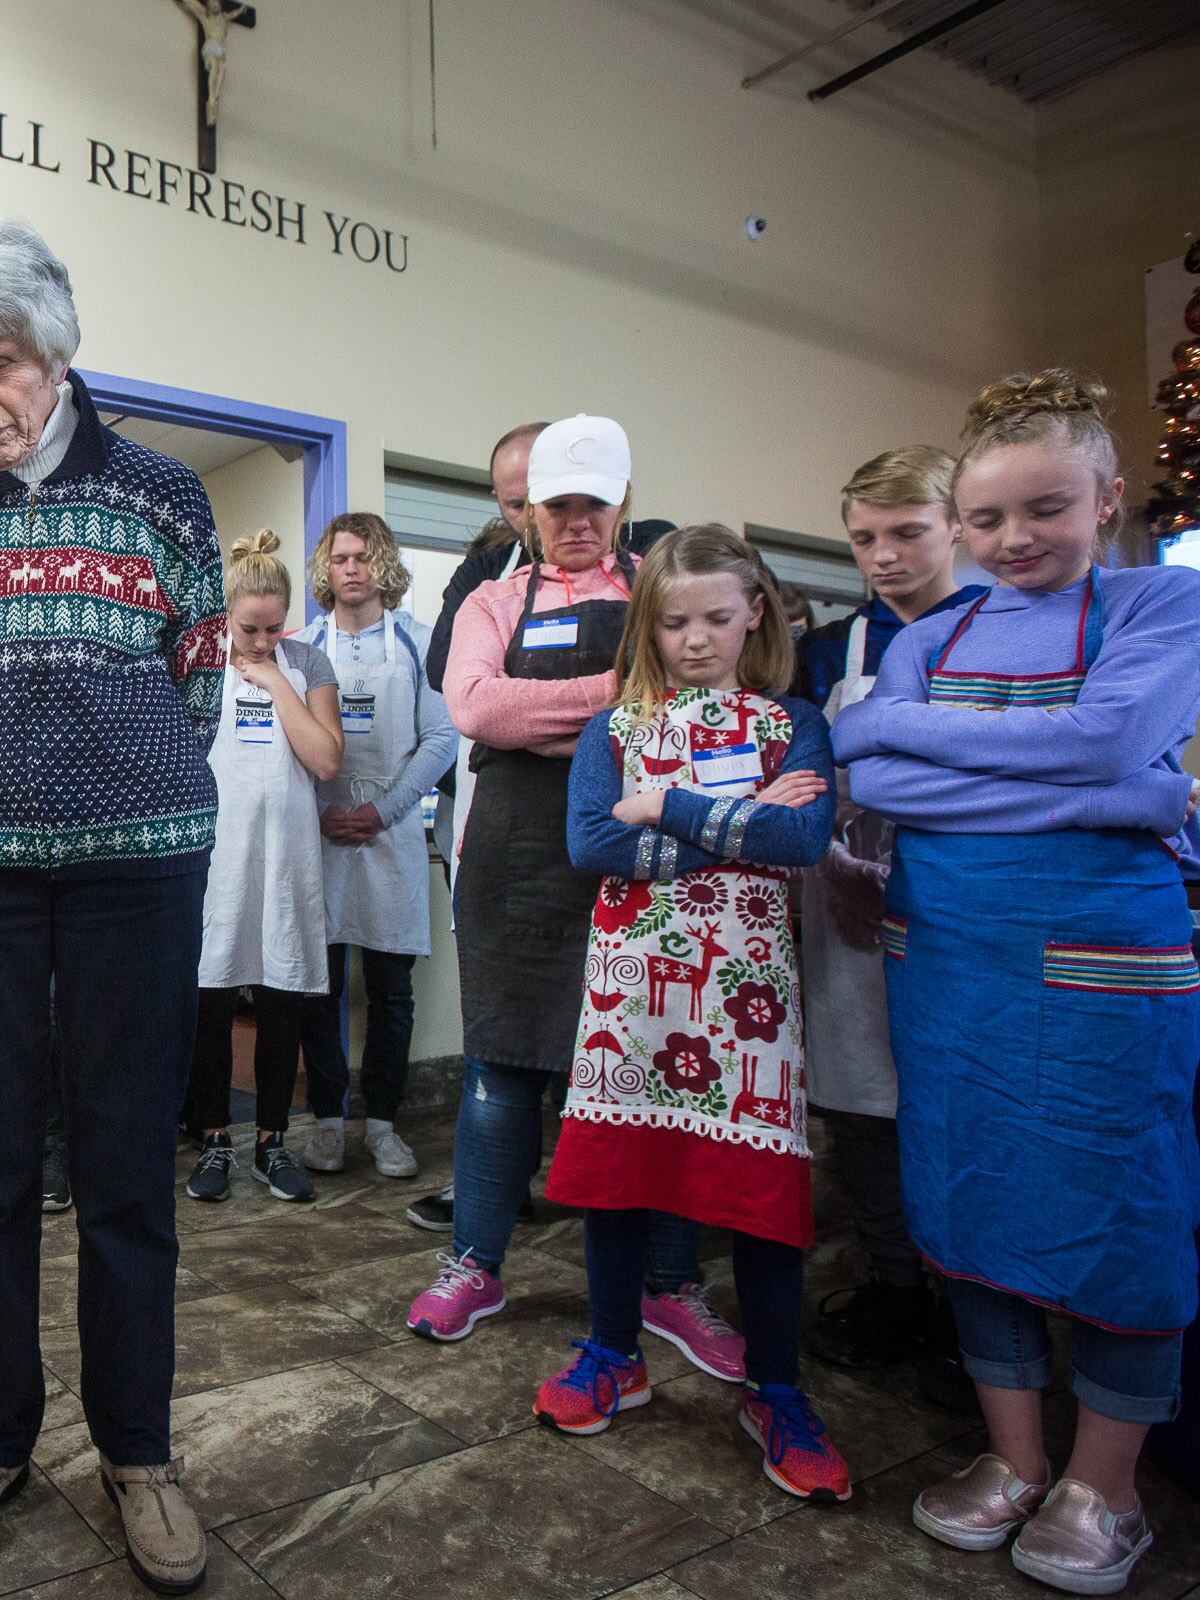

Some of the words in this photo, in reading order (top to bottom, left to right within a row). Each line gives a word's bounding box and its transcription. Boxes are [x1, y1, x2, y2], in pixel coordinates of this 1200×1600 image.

[86, 137, 307, 245] REFRESH
[322, 210, 410, 273] YOU
[235, 708, 273, 717] DINNER
[711, 747, 732, 756] Hello
